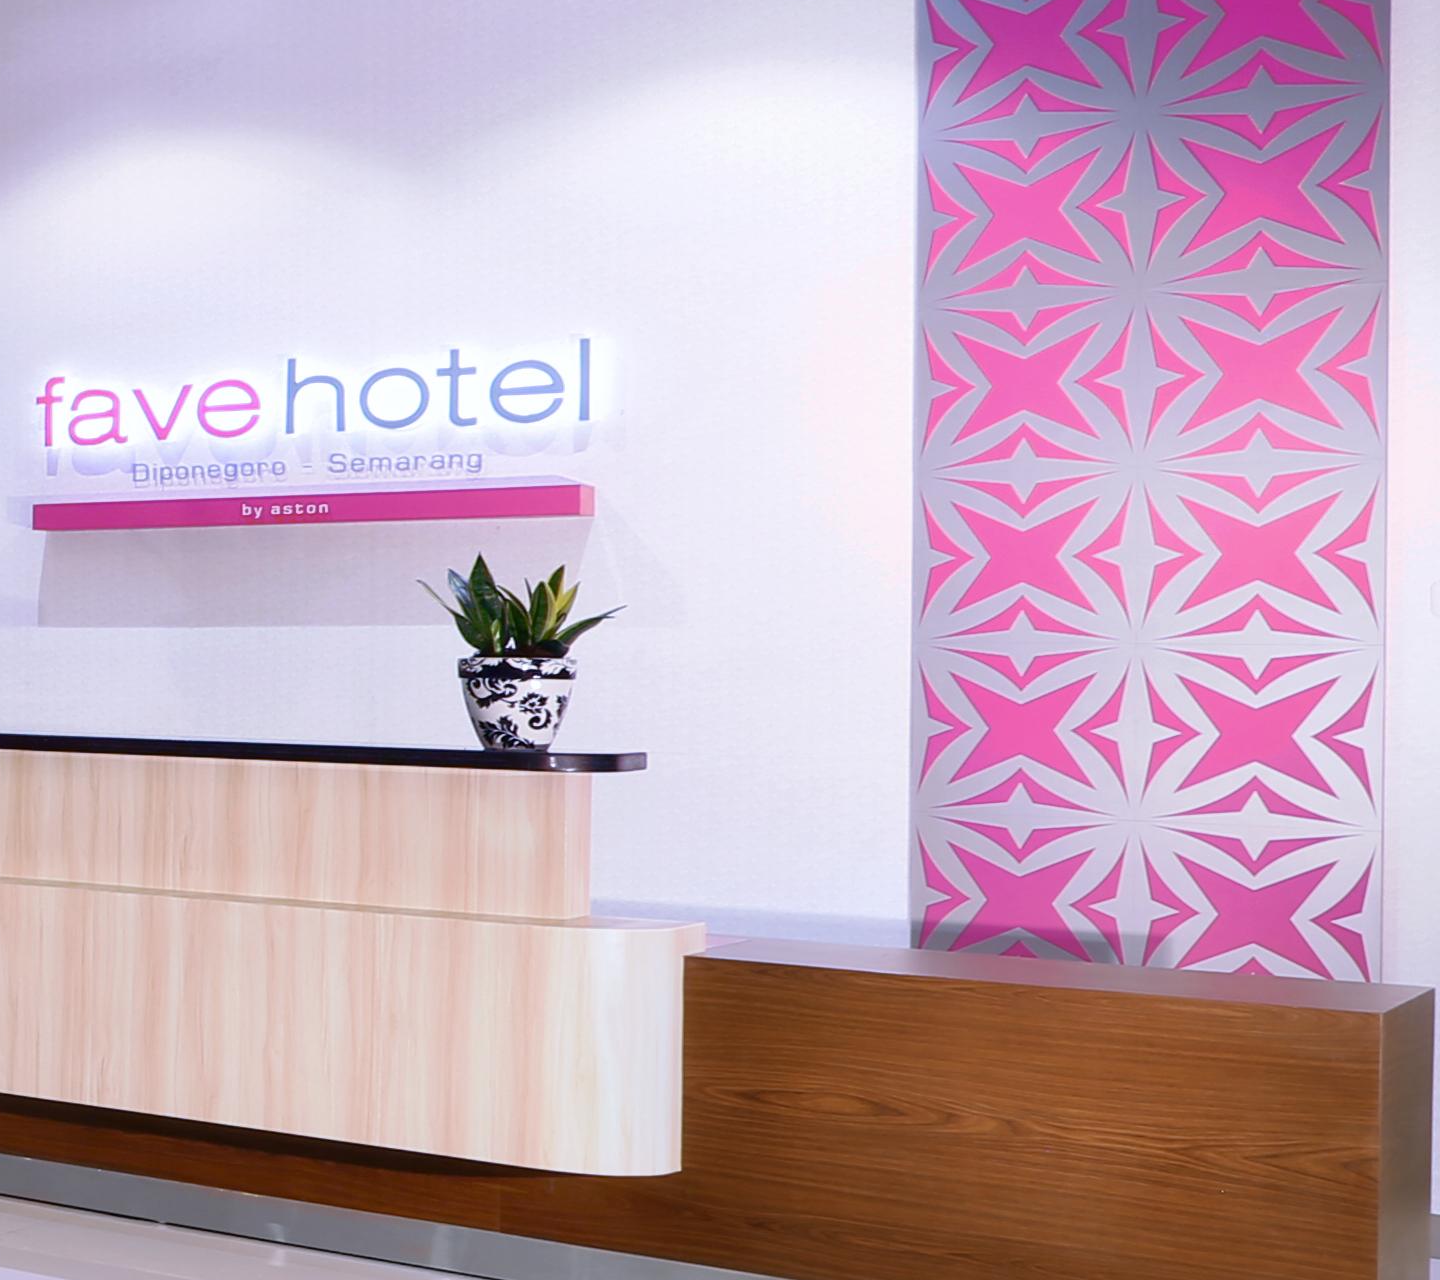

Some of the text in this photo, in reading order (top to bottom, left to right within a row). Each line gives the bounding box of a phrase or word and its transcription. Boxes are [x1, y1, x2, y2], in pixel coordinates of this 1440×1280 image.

[132, 461, 286, 486] Diponegoro
[328, 453, 483, 474] Semarang
[241, 503, 329, 518] by aston
